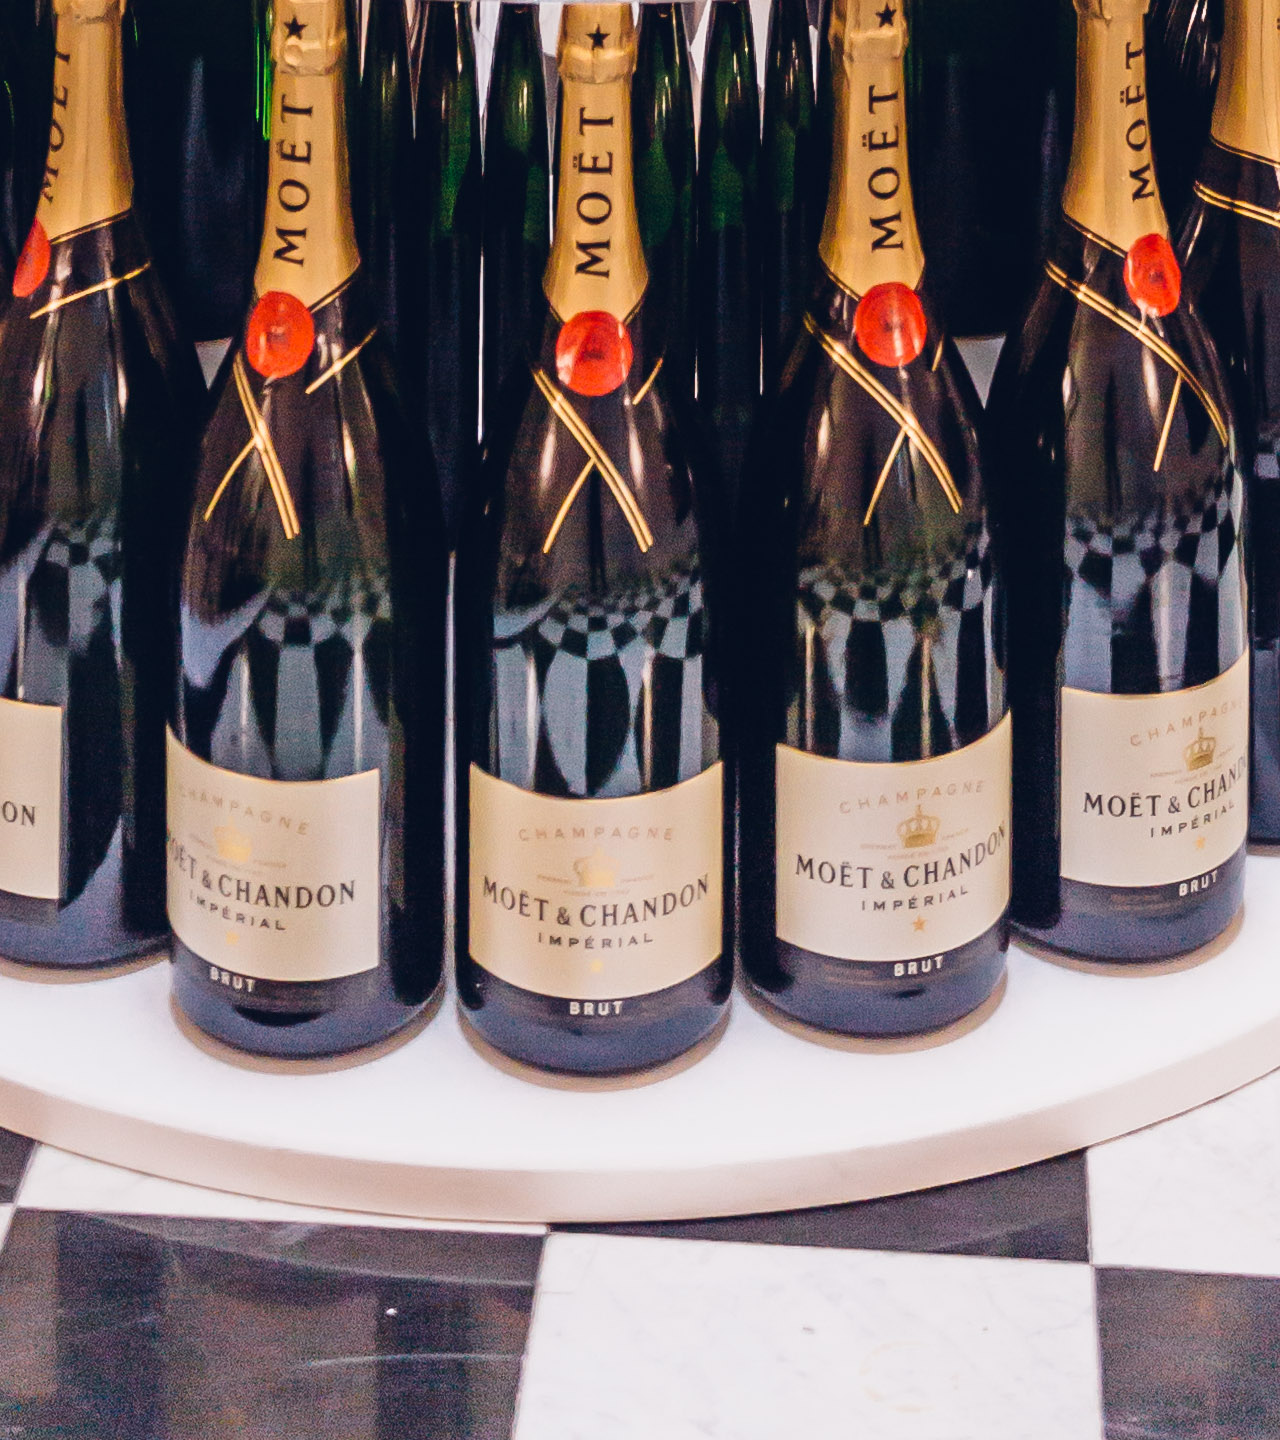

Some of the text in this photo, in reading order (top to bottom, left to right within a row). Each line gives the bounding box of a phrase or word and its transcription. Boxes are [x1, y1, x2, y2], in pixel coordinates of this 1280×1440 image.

[862, 85, 903, 252] MOËT
[573, 107, 612, 278] MOËT
[840, 780, 985, 814] CHAMPAGNE
[1083, 792, 1161, 817] MOËT
[1168, 795, 1181, 813] &
[519, 827, 673, 841] CHAMPAGNE
[1151, 801, 1235, 838] IMPÉRIAL
[795, 820, 1005, 889] MOËT & CHANDON
[202, 870, 355, 909] & CHANDON
[862, 886, 969, 911] IMPÉRIAL
[1179, 870, 1218, 897] BRUT
[189, 891, 286, 931] IMPÉRIAL
[483, 873, 709, 927] MOËT & CHANDON
[538, 933, 653, 949] IMPÉRIAL
[210, 967, 255, 992] BRUT
[894, 956, 944, 977] BRUT
[570, 1001, 623, 1015] BRUT
